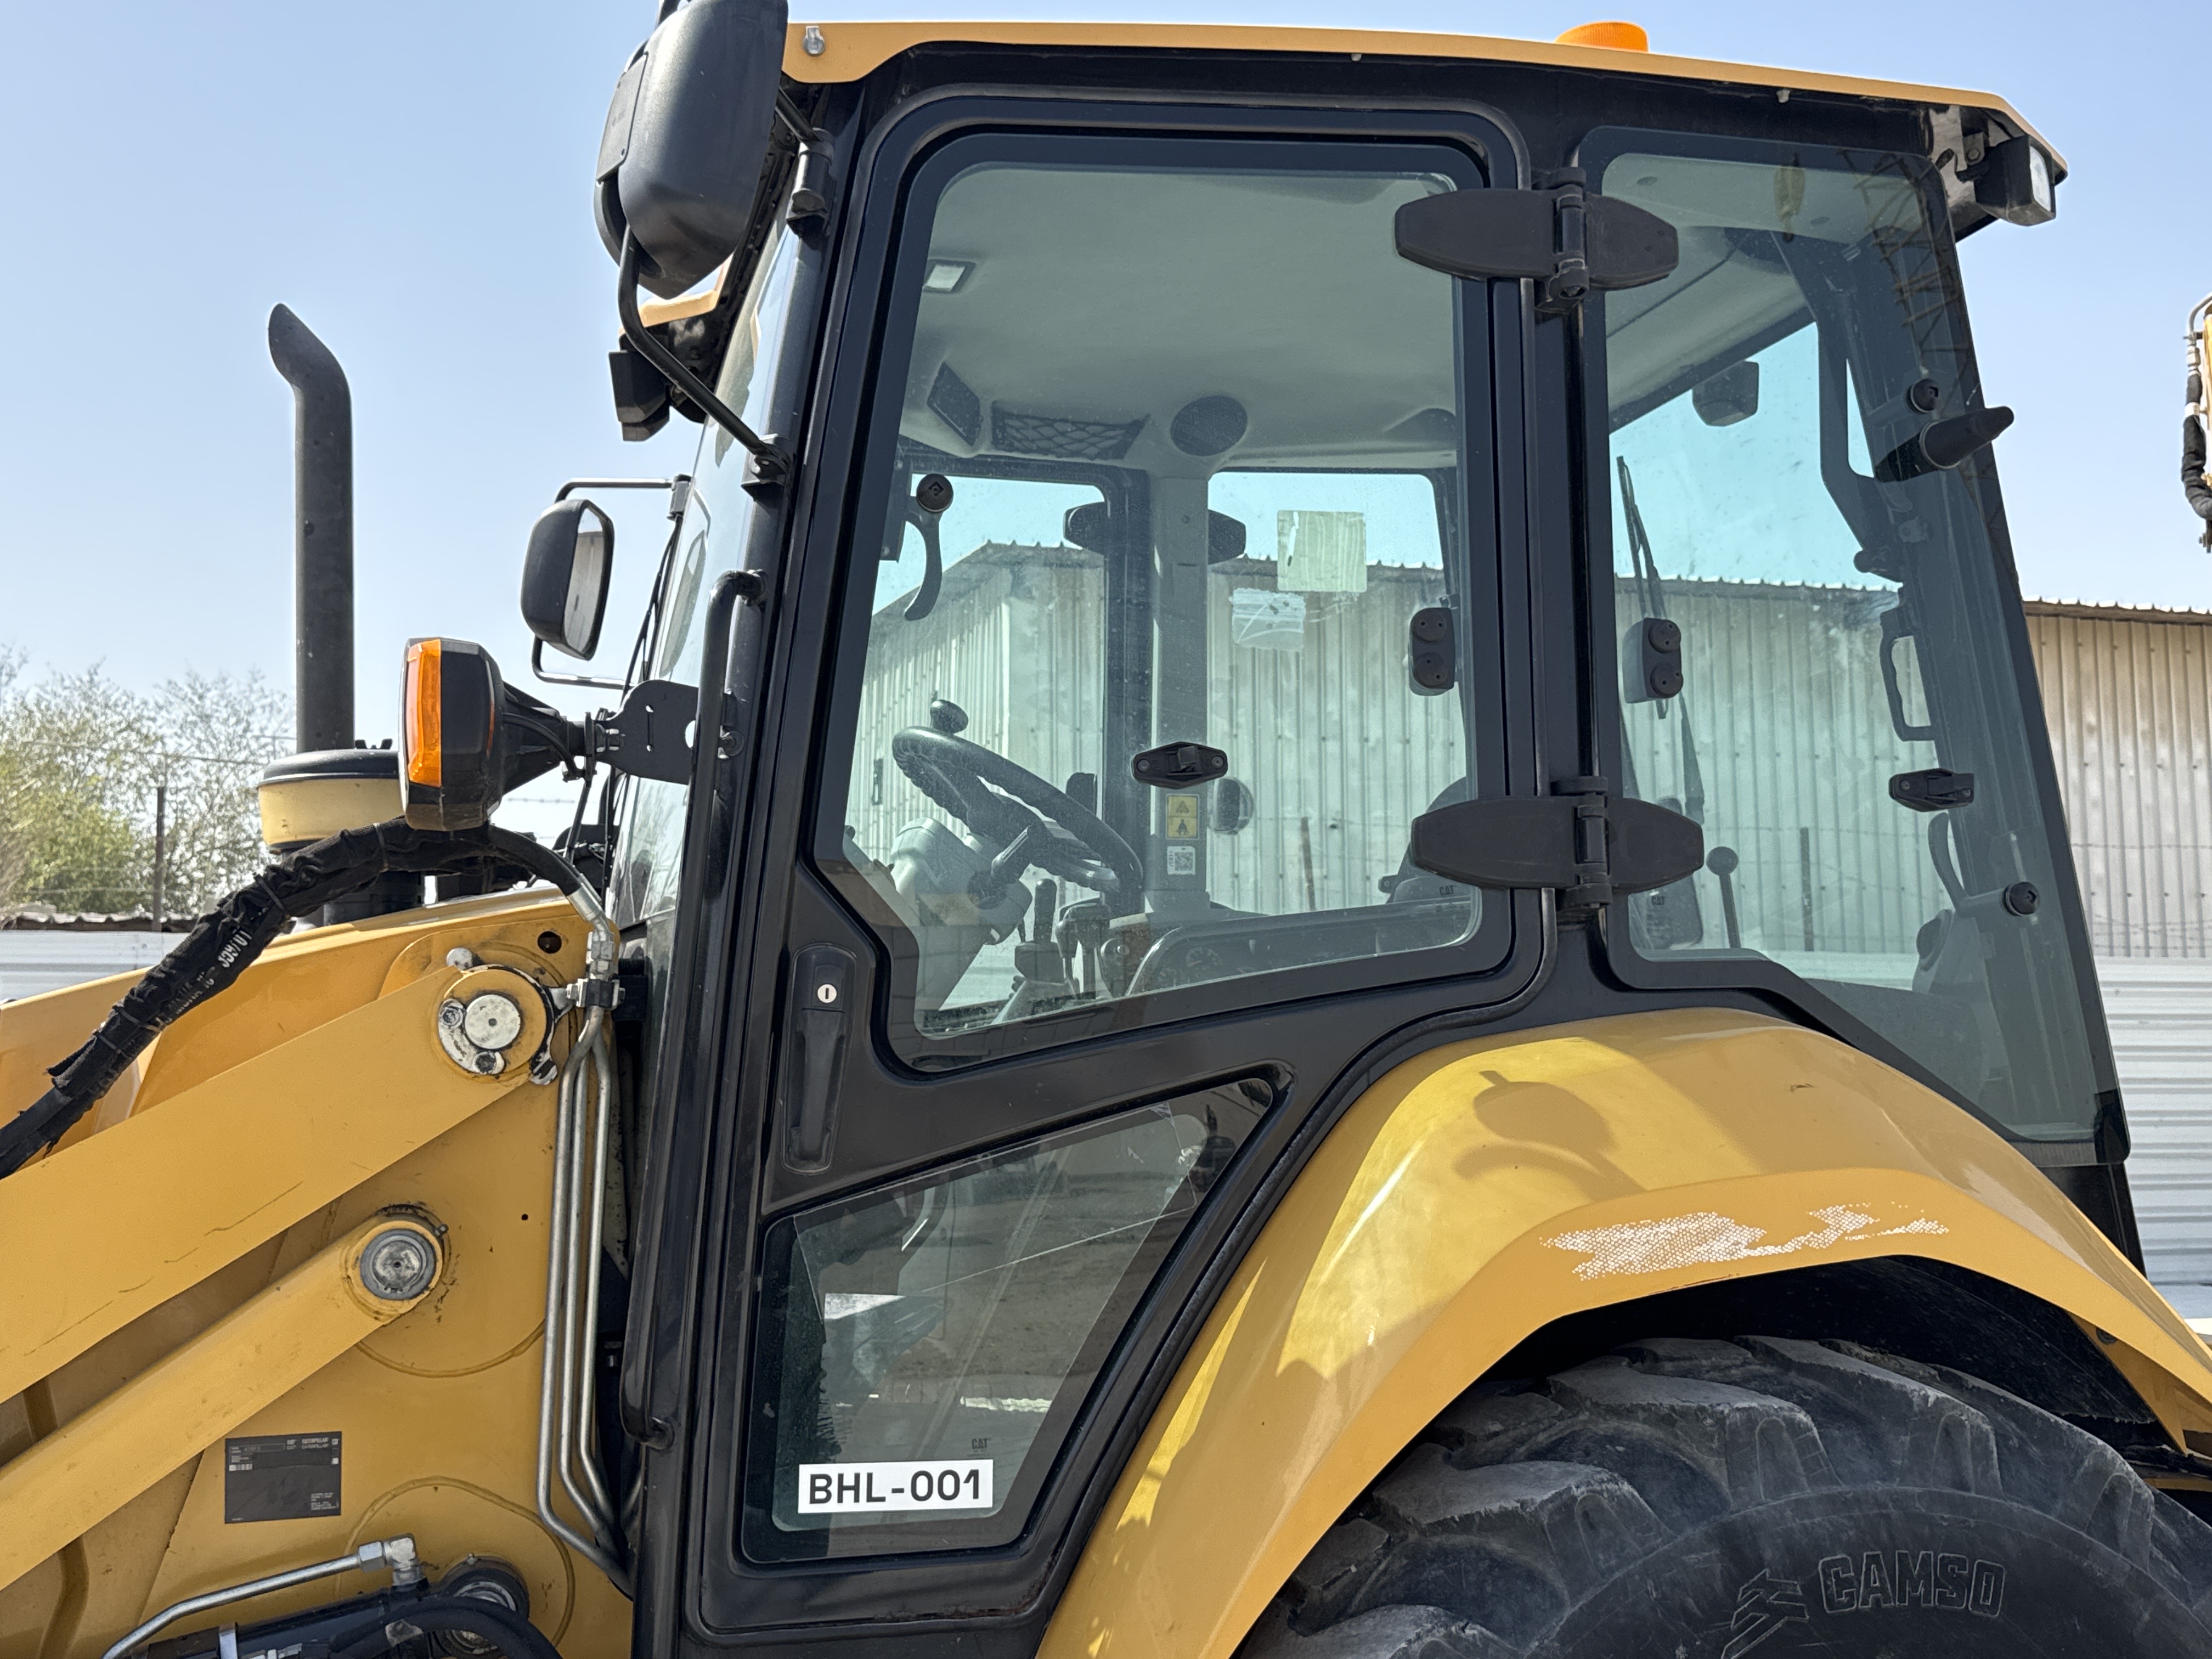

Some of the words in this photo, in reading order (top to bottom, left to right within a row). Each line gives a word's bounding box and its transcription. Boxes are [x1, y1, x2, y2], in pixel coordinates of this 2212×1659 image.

[972, 1437, 988, 1449] CAT
[809, 1469, 980, 1504] BHL-001
[1818, 1549, 2006, 1620] CAMSO
